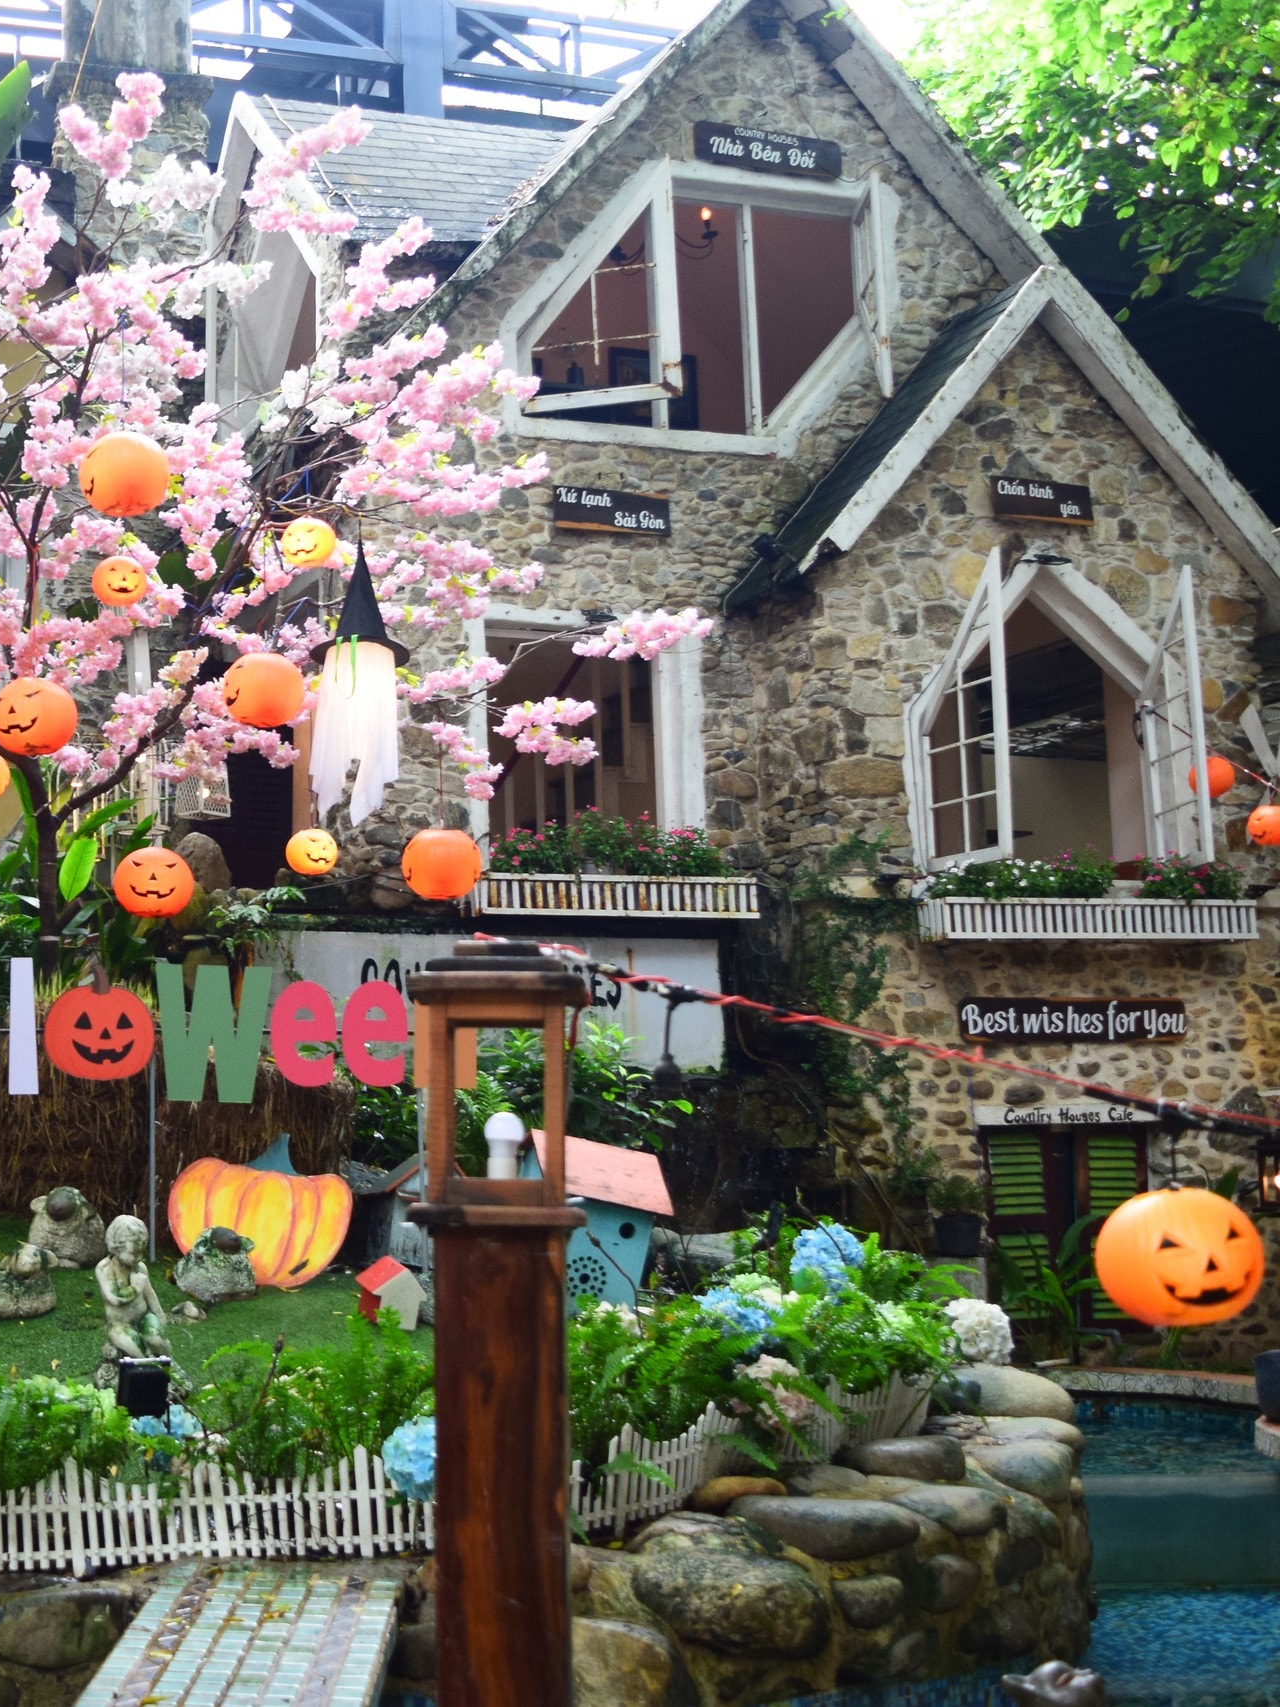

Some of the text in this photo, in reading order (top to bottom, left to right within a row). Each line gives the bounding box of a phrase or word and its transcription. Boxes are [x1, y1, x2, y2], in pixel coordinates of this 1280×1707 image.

[734, 127, 799, 147] COUNTRY HOUSES
[709, 136, 817, 169] Nhà Bên Đồi
[556, 487, 613, 508] Xứ lạnh
[997, 479, 1055, 500] Chốn bình
[1059, 500, 1081, 518] yên
[614, 510, 666, 530] Sài Gòn
[961, 1003, 1019, 1034] Best
[1022, 1006, 1104, 1034] wishes
[1107, 1000, 1140, 1040] for
[1058, 1107, 1100, 1124] Houses
